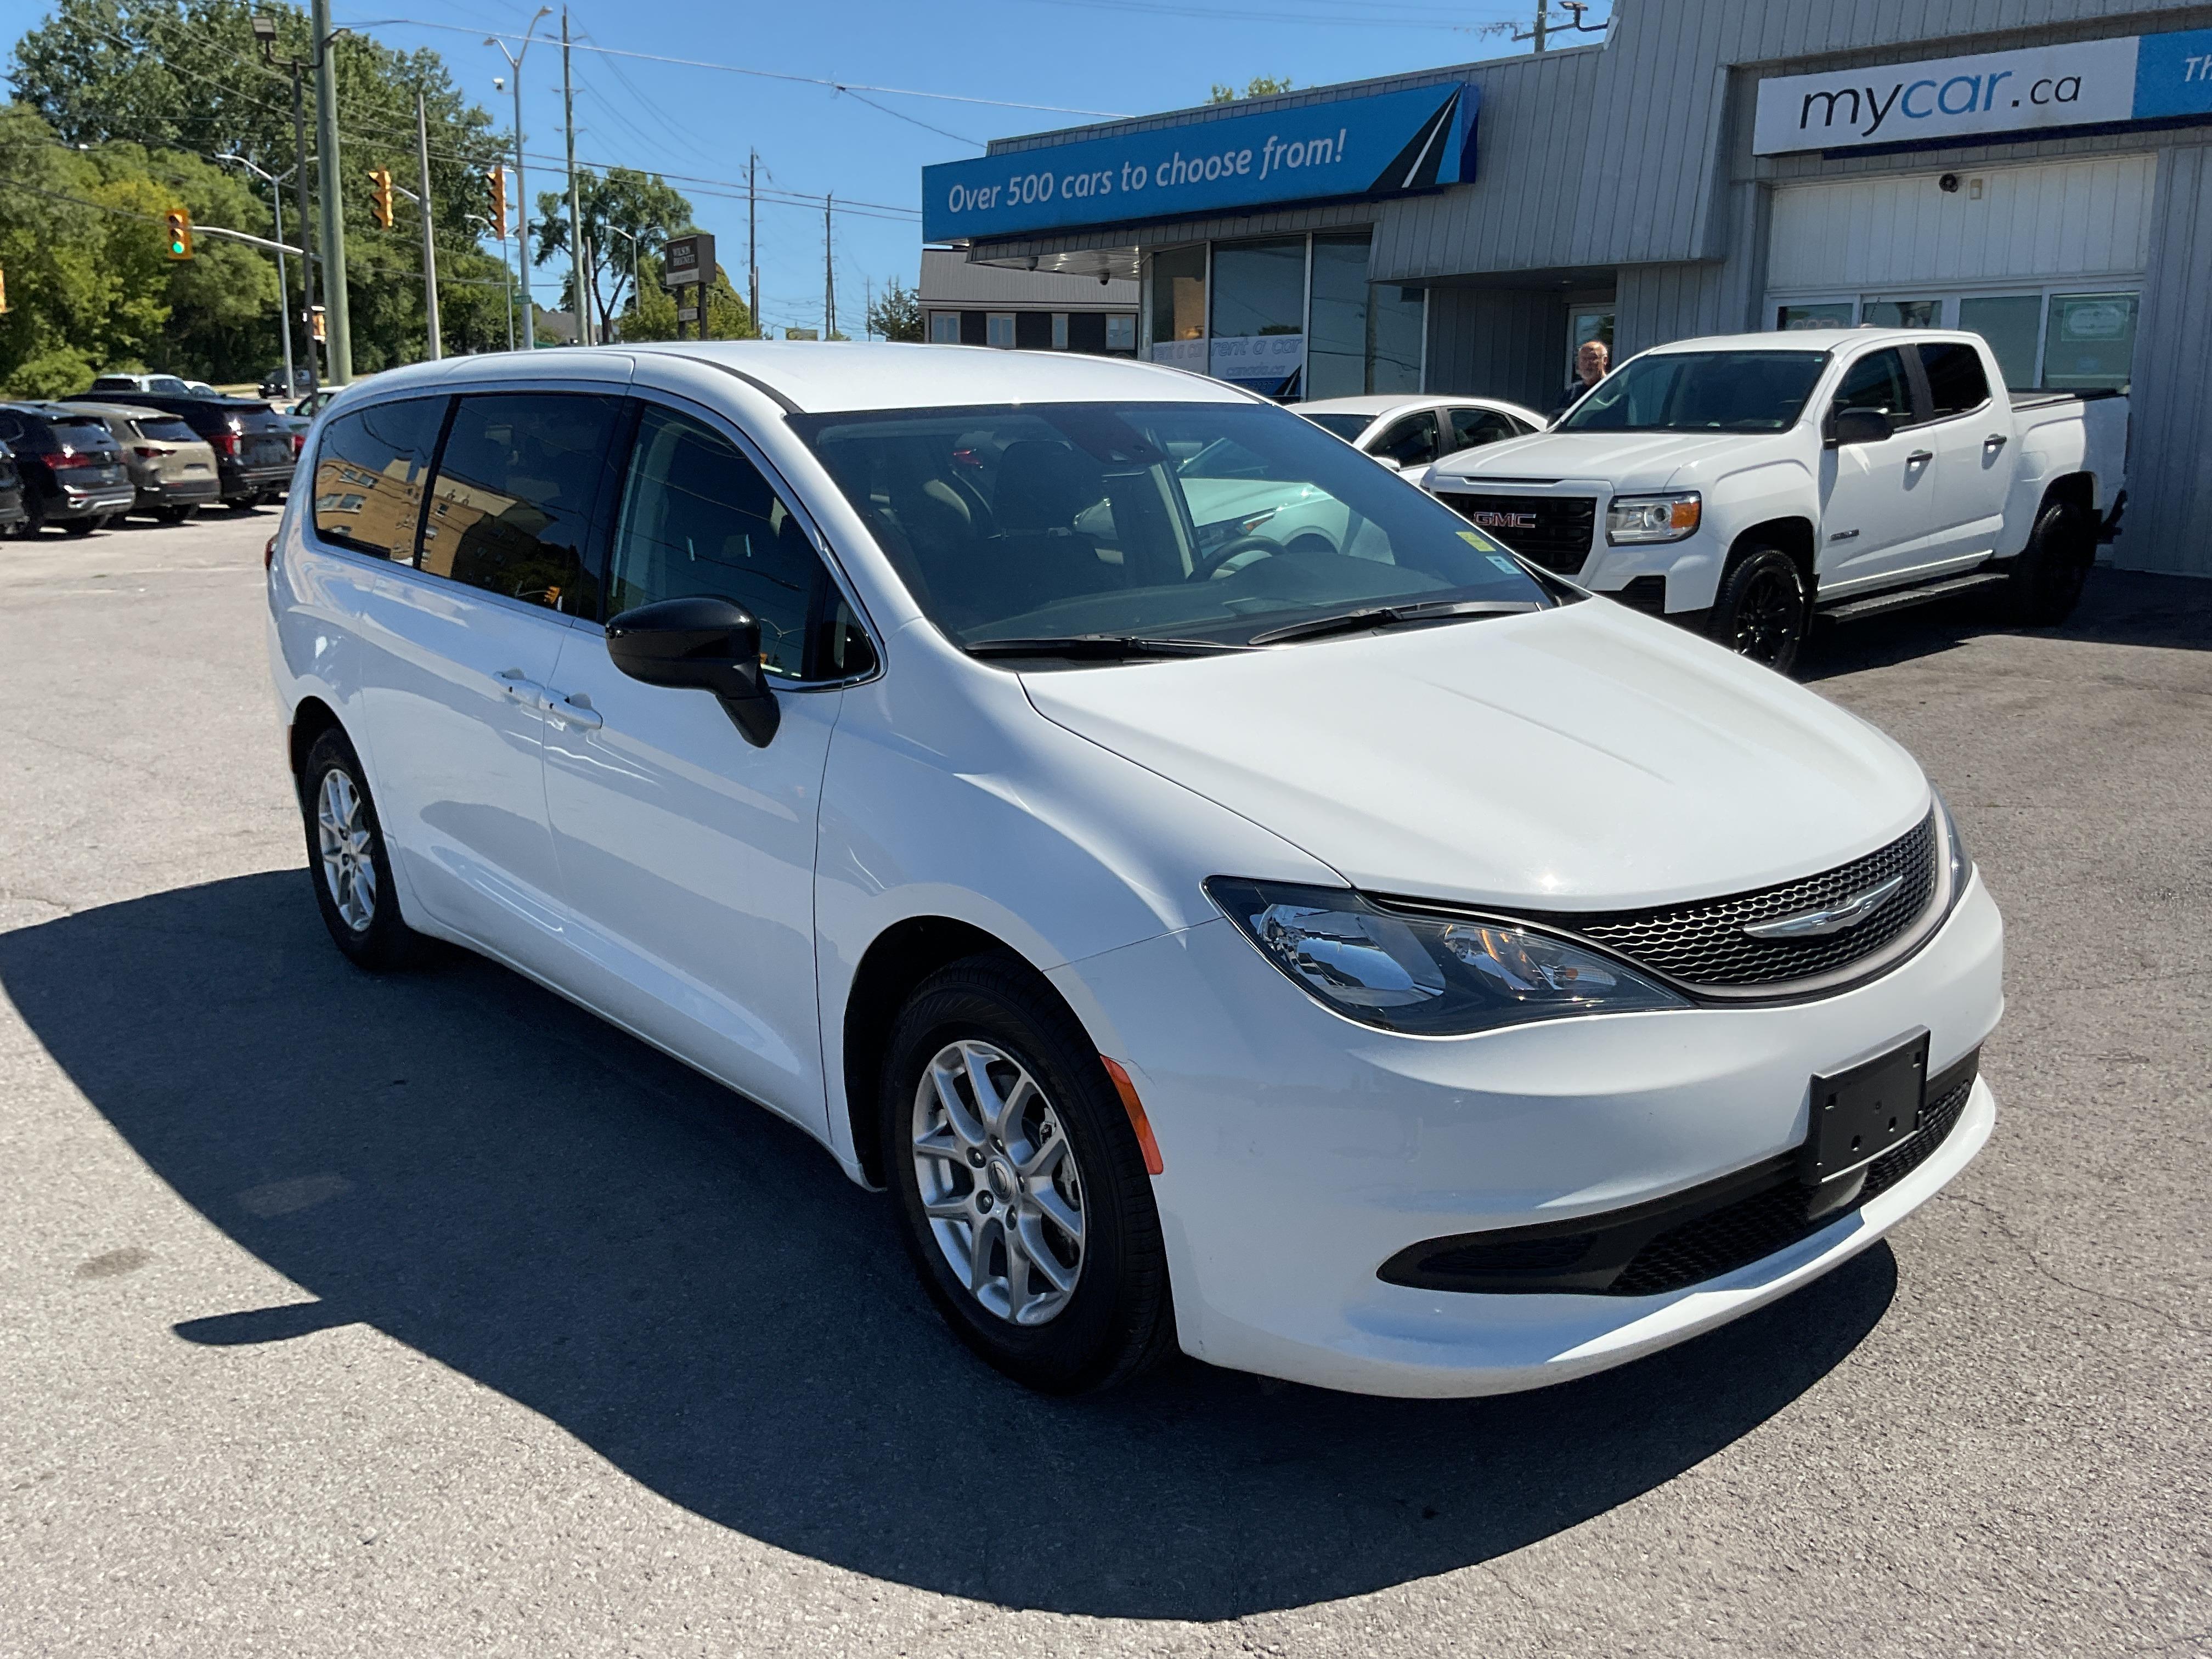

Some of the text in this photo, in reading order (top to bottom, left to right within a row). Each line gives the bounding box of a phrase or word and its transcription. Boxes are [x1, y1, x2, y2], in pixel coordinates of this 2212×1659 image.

[1799, 70, 2083, 137] mycar.ca
[948, 128, 1347, 213] Over 500 cars to choose from!
[1211, 337, 1302, 357] rent a car
[1474, 511, 1536, 528] GMC
